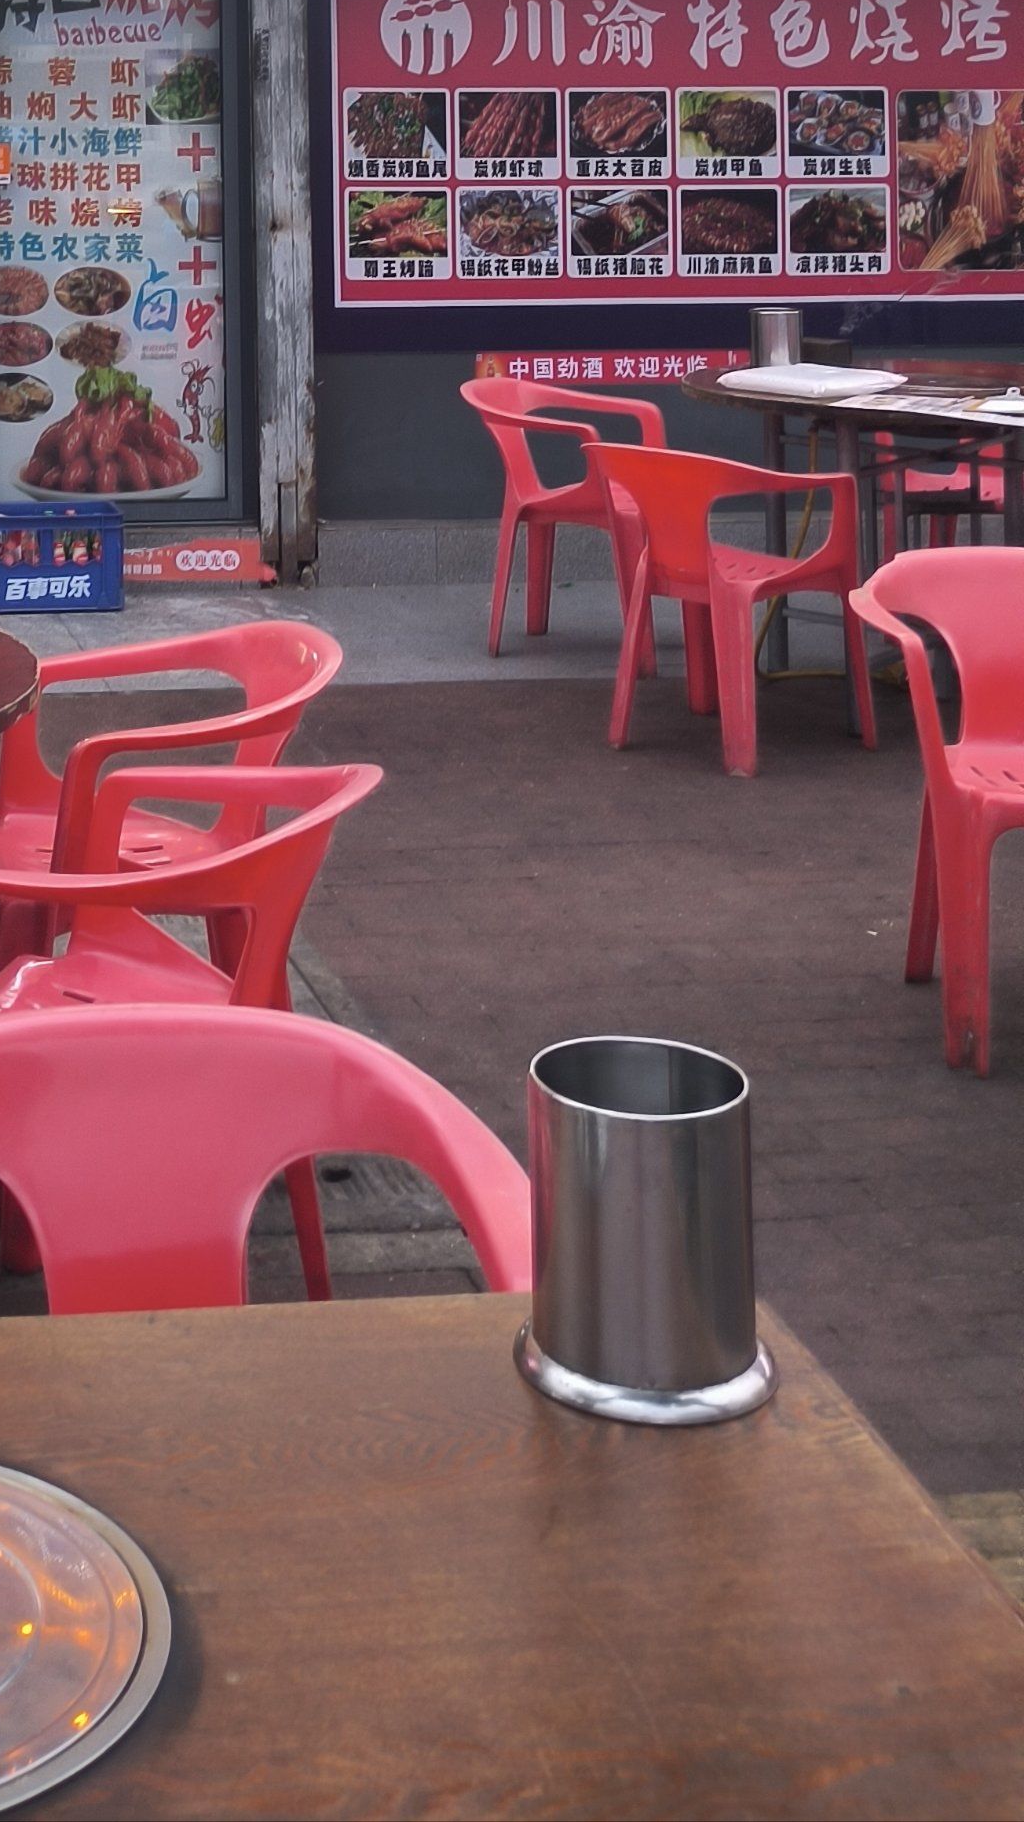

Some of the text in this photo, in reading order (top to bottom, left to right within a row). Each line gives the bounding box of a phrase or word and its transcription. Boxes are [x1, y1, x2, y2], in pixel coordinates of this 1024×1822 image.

[53, 17, 163, 47] barbecue
[474, 159, 543, 178] 炭烤虾球
[695, 158, 763, 177] 炭烤甲鱼
[803, 157, 872, 176] 炭烤生蚝
[3, 161, 143, 193] 球拼花甲
[461, 258, 559, 277] 锡纸花甲粉丝
[686, 256, 773, 275] 川渝麻辣鱼
[795, 255, 882, 274] 凉拌猪头肉
[508, 354, 708, 380] 中国劲酒 欢迎光临
[5, 574, 92, 602] 百事可乐
